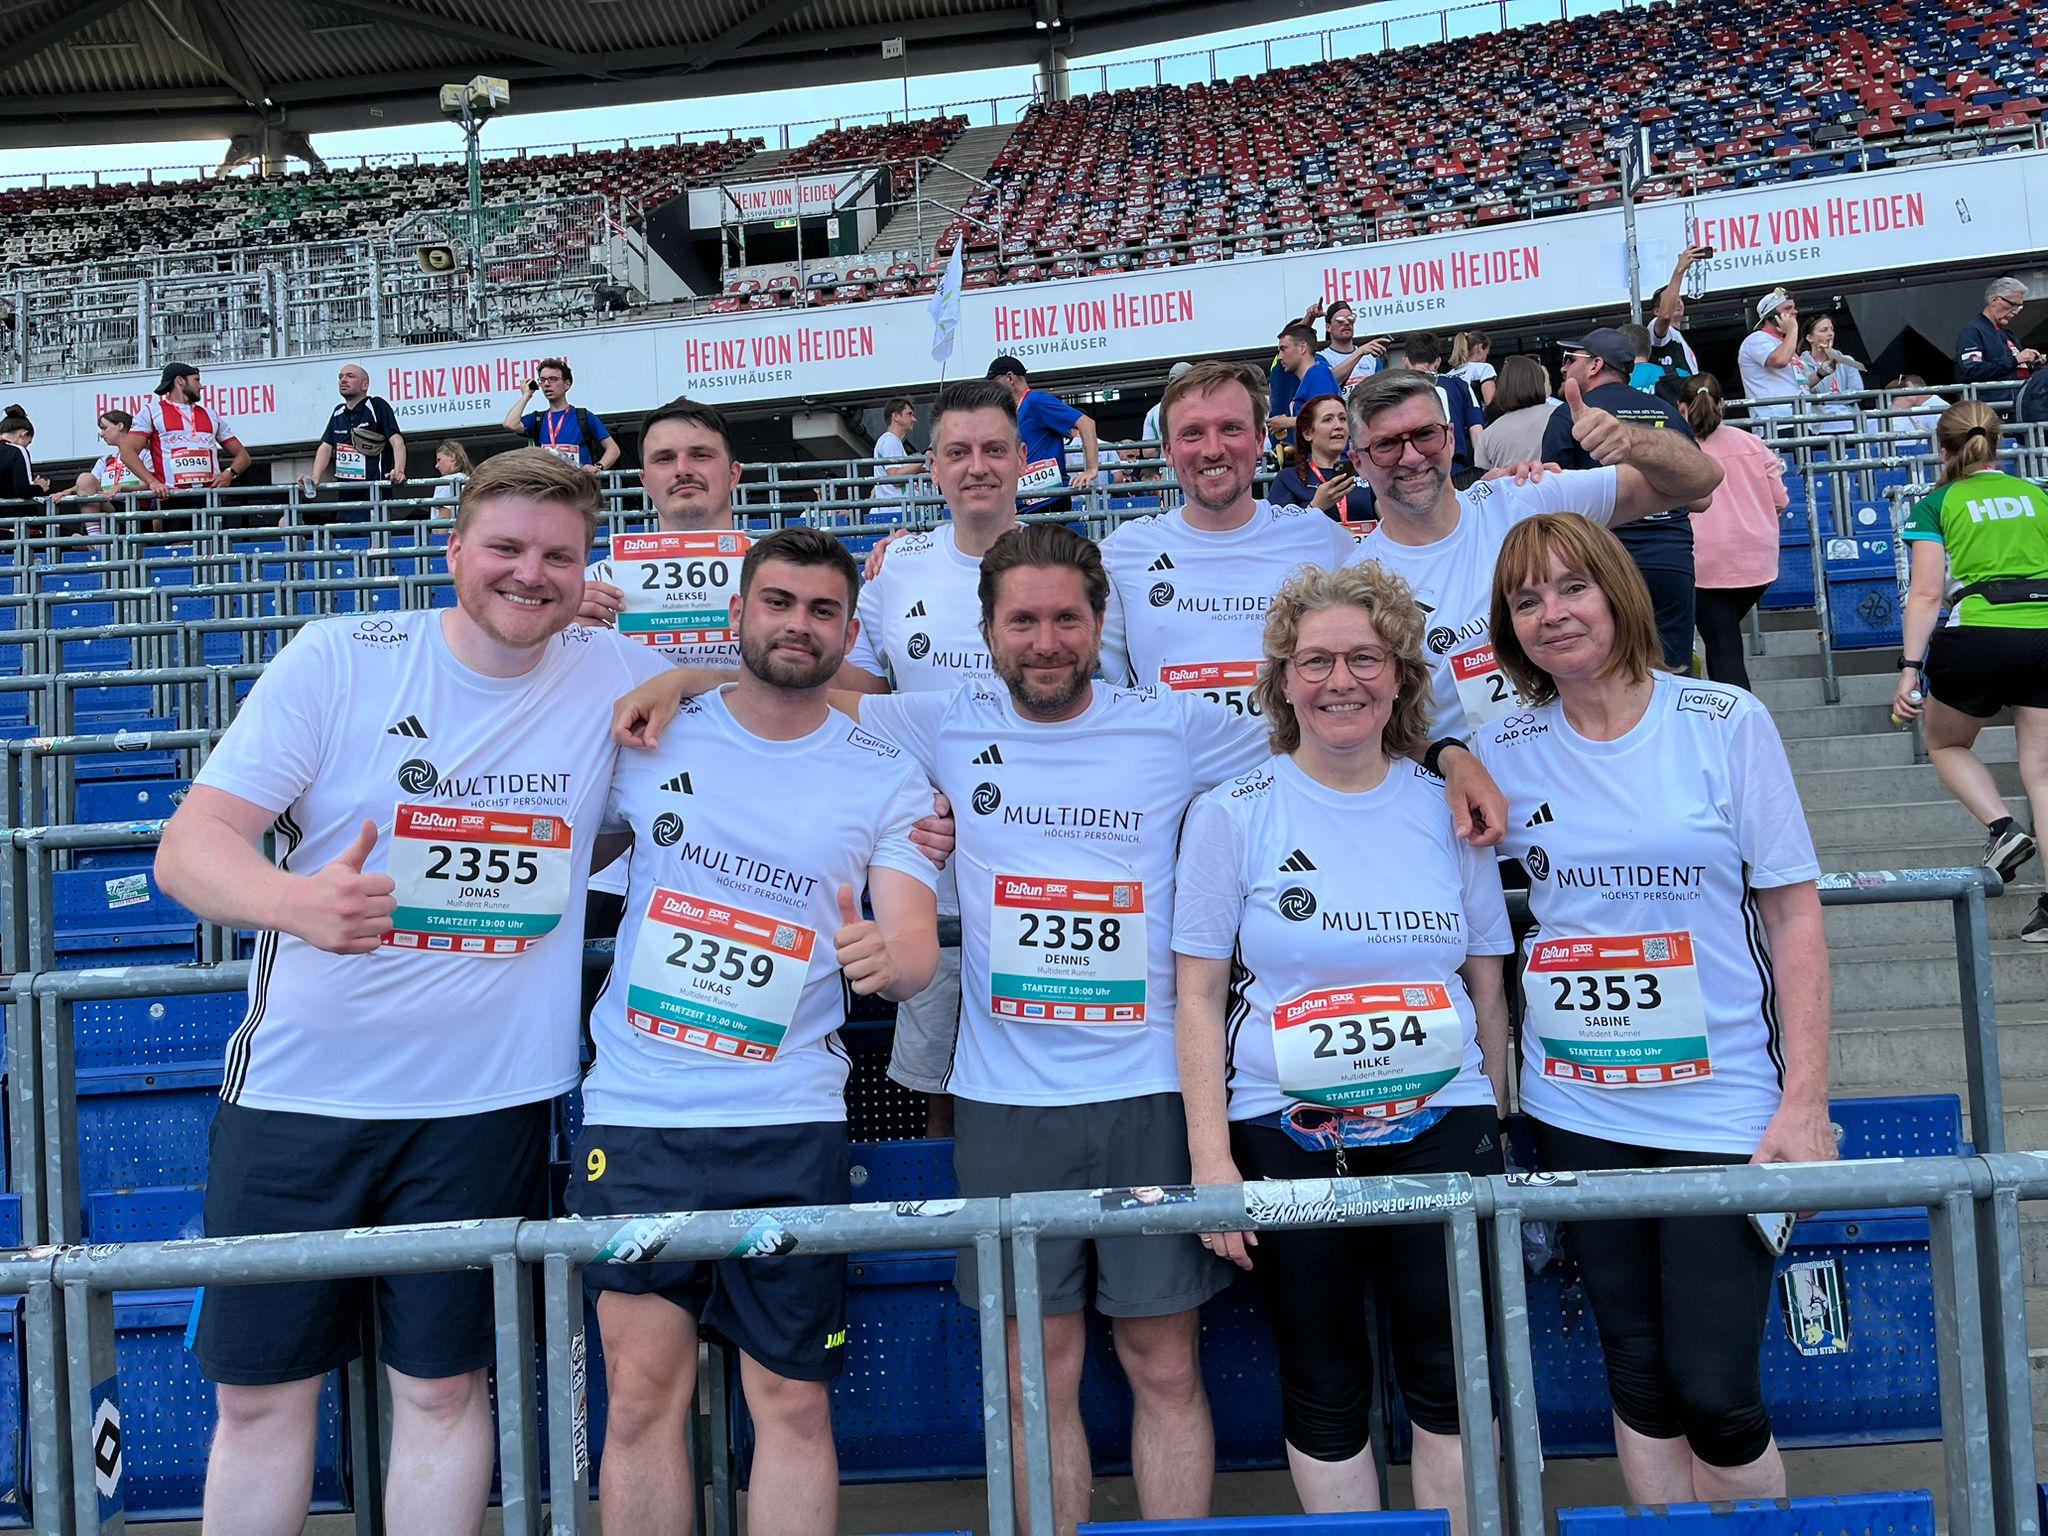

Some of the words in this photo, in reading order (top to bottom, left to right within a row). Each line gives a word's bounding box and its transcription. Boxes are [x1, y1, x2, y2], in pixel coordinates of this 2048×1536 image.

[770, 188, 792, 206] VON
[1768, 206, 1820, 245] VON
[1827, 192, 1926, 238] HEIDEN
[1704, 246, 1822, 272] ASSIVHÄUSER
[1324, 266, 1392, 305] HEINZ
[1398, 259, 1445, 296] VON
[1451, 246, 1540, 290] HEIDEN
[994, 304, 1058, 342] HEINZ
[1064, 300, 1106, 334] VON
[1112, 290, 1194, 329] HEIDEN
[1350, 297, 1446, 318] SSIVHÄUSER
[686, 338, 746, 374] HEINZ
[752, 334, 792, 367] VON
[798, 326, 874, 362] HEIDEN
[997, 336, 1108, 358] MASSIVHÄUSER
[388, 367, 447, 402] HEINZ
[452, 363, 491, 396] VON
[688, 370, 792, 390] MASSIVHÄUSER
[202, 384, 275, 416] HEIDEN
[394, 398, 492, 416] MASSIVHÄUSER
[175, 456, 208, 468] 50946
[108, 469, 131, 480] 625
[1020, 468, 1055, 487] 11404
[1966, 496, 2036, 522] HDI
[624, 540, 658, 550] B2Run
[896, 546, 914, 554] CAD
[914, 542, 934, 552] CAM
[640, 560, 728, 590] 2360
[666, 592, 707, 601] ALEKSEJ
[690, 616, 710, 624] 19:00
[353, 632, 378, 642] CAD
[381, 632, 408, 643] CAM
[932, 652, 990, 669] MULTI
[962, 672, 991, 680] HÖCHST
[1170, 670, 1198, 680] B2Run
[1684, 692, 1730, 712] valisy
[854, 733, 896, 754] valisy
[1494, 730, 1520, 744] CAD
[1522, 724, 1548, 737] CAM
[1505, 734, 1540, 749] VALLEY
[433, 774, 570, 798] MULTIDENT
[1232, 784, 1254, 798] CAD
[1256, 775, 1276, 790] CAM
[471, 798, 510, 808] HÖCHST
[412, 812, 457, 828] B2Run
[1004, 806, 1144, 831] MULTIDENT
[1044, 828, 1080, 838] HÖCHST
[425, 845, 538, 885] 2355
[680, 842, 818, 896] MULTIDENT
[716, 876, 753, 894] HÖCHST
[1556, 866, 1706, 888] MULTIDENT
[459, 887, 500, 898] JONAS
[1006, 882, 1042, 896] B2Run
[1601, 892, 1640, 900] HÖCHST
[446, 900, 482, 908] Multident
[484, 901, 510, 910] Runner
[664, 897, 704, 918] B2Run
[427, 916, 477, 927] STARTZEIT
[480, 919, 504, 928] 19:00
[508, 920, 524, 928] Uhr
[1322, 911, 1460, 932] MULTIDENT
[1018, 913, 1120, 952] 2358
[1368, 934, 1407, 944] HÖCHST
[666, 932, 774, 988] 2359
[1045, 954, 1090, 966] DENNIS
[1038, 966, 1070, 976] Multident
[1072, 968, 1096, 977] Runner
[692, 977, 732, 996] LUKAS
[1022, 983, 1067, 994] STARTZEIT
[1069, 984, 1094, 996] 19:00
[1095, 986, 1110, 996] Uhr
[1550, 974, 1662, 1011] 2353
[679, 987, 711, 1002] Multident
[712, 996, 738, 1010] Runner
[1287, 998, 1328, 1018] B2Run
[660, 1001, 705, 1020] STARTZEIT
[706, 1013, 730, 1027] 19:00
[732, 1020, 748, 1031] Uhr
[1584, 1016, 1631, 1026] SABINE
[1308, 1016, 1427, 1059] 2354
[1578, 1030, 1612, 1038] Multident
[1614, 1030, 1641, 1038] Runner
[1568, 1048, 1612, 1057] STARTZEIT
[1615, 1048, 1642, 1057] 19:00
[1644, 1048, 1662, 1056] Uhr
[1353, 1056, 1390, 1070] HILKE
[1341, 1071, 1376, 1082] Multident
[1378, 1067, 1404, 1076] Runner
[1326, 1088, 1374, 1102] STARTZEIT
[1377, 1084, 1402, 1095] 19:00
[1405, 1082, 1421, 1092] Uhr
[587, 1148, 606, 1182] 9
